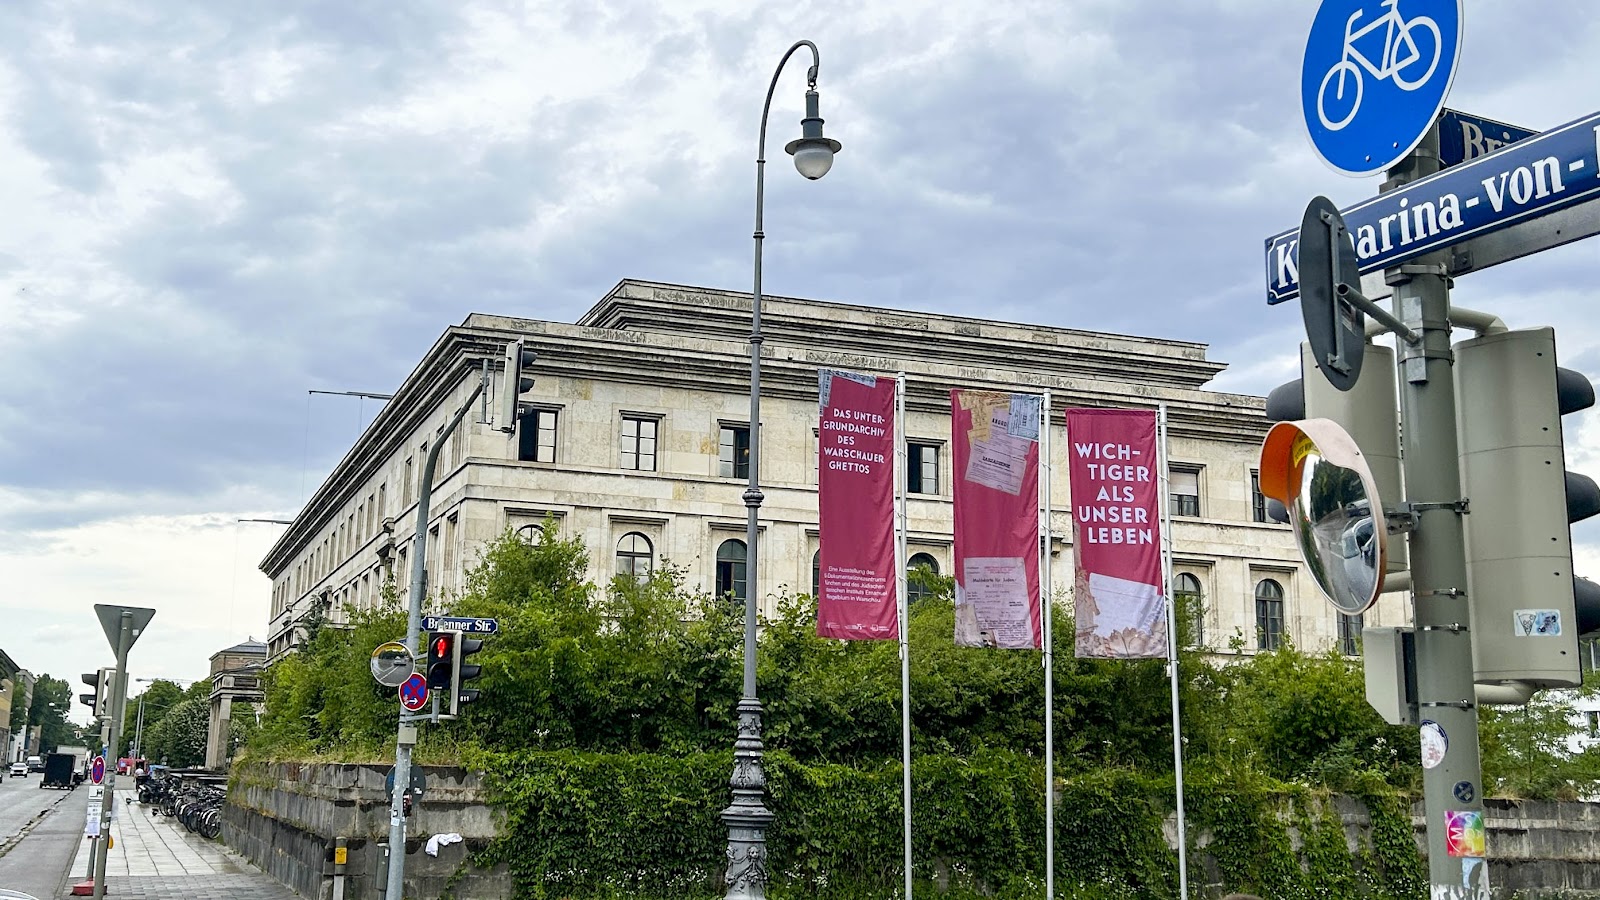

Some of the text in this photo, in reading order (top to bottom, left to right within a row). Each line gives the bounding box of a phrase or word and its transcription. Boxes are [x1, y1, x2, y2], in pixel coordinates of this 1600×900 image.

[1276, 124, 1600, 288] Karina-von-
[833, 408, 885, 424] DAS UNTER-
[823, 421, 885, 437] GRUNDARCHIV
[837, 435, 855, 445] DES
[823, 447, 884, 463] WARSCHAUER
[1074, 442, 1141, 460] WICH-
[828, 461, 870, 474] GHETTOS
[1087, 463, 1150, 482] TIGER
[1096, 485, 1135, 503] ALS
[1078, 505, 1148, 524] UNSER
[1088, 527, 1153, 545] LEBEN
[427, 617, 492, 632] Brenner Str.
